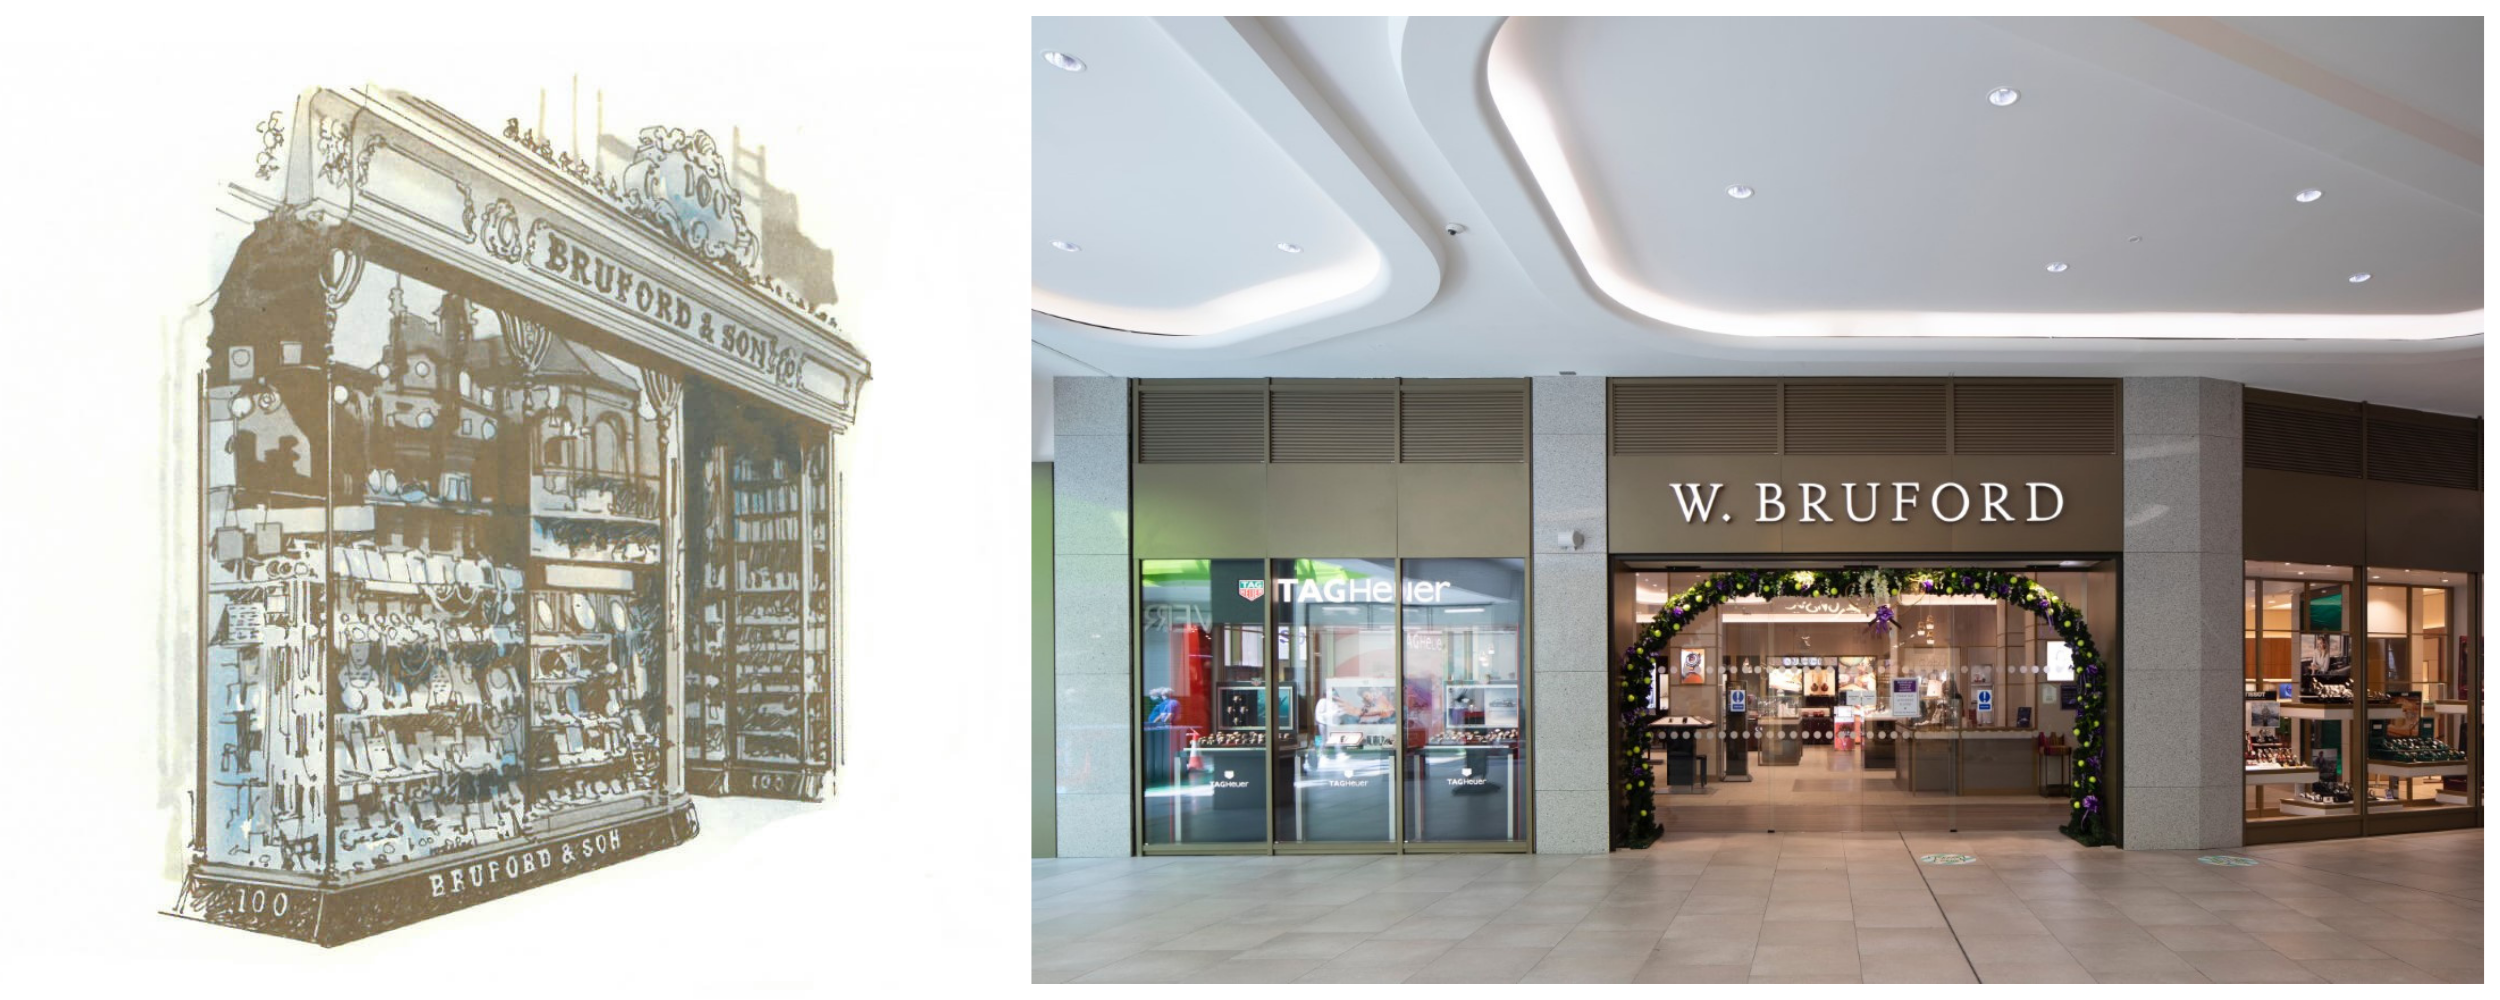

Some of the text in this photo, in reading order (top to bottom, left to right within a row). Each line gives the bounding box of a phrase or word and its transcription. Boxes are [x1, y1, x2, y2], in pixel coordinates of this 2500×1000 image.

[683, 163, 727, 220] 100
[545, 231, 692, 331] BRUFORD
[699, 311, 715, 344] &
[1669, 482, 2064, 523] W. BRUFORD
[1241, 580, 1263, 589] TAG
[561, 843, 577, 865] &
[236, 888, 288, 917] 100
